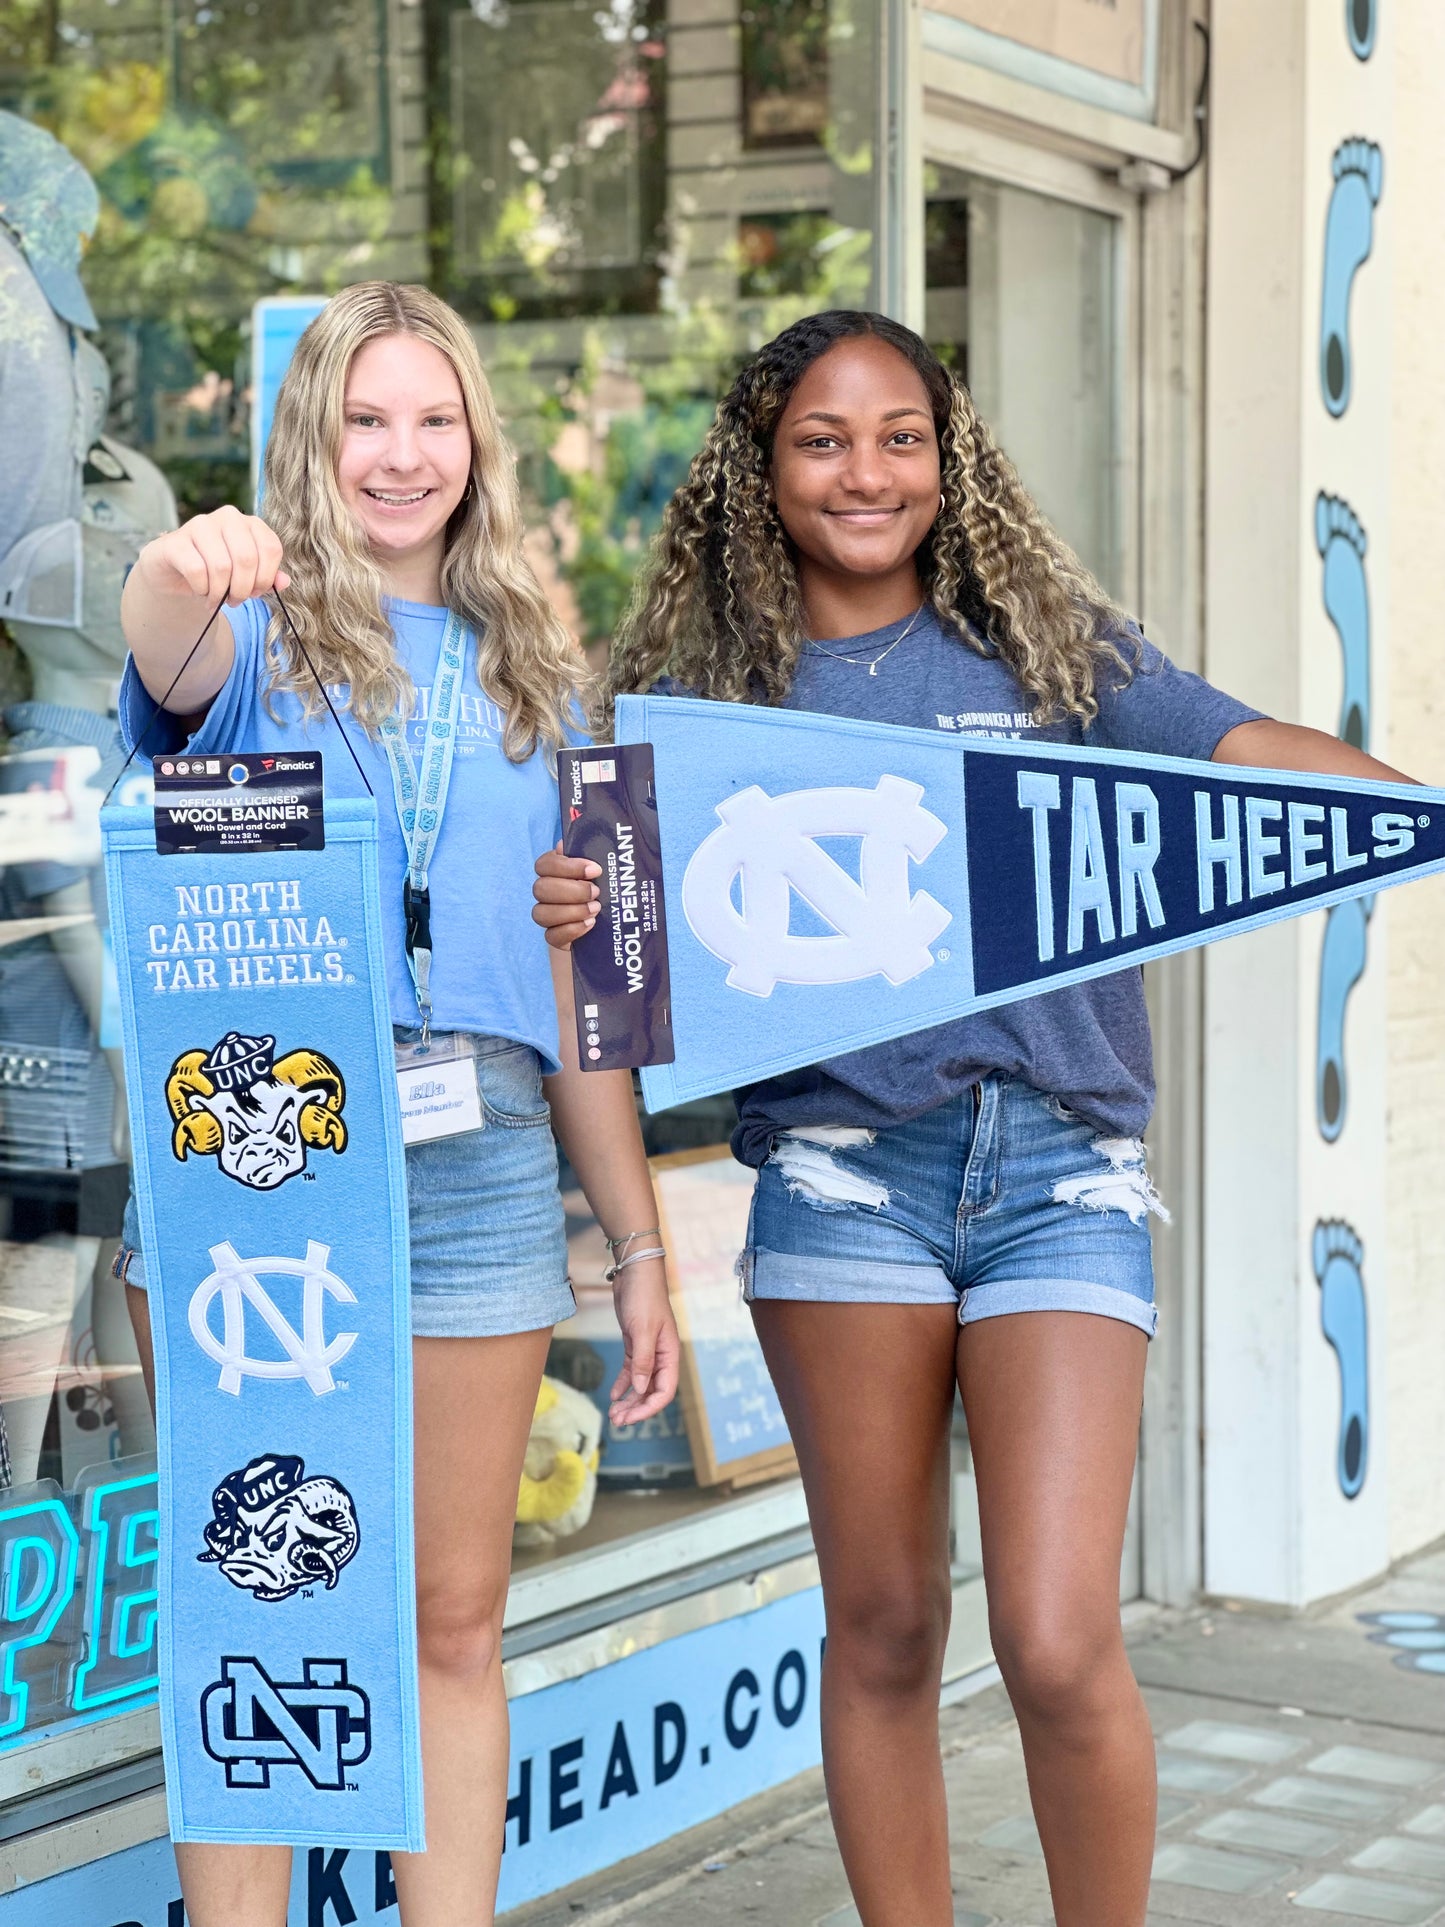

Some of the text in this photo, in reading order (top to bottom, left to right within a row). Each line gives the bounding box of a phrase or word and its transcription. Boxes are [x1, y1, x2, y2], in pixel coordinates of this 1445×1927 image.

[437, 673, 455, 719] CAROLINA
[936, 714, 957, 729] THE
[956, 712, 1012, 728] SHRUNKEN
[276, 761, 315, 771] Fanatics
[391, 740, 413, 800] CAROLINA
[425, 744, 445, 804] CAROLINA
[570, 760, 582, 805] Fanatics
[169, 805, 309, 823] WOOL BANNER
[179, 795, 299, 807] OFFICIALLY LICENSED
[193, 821, 286, 832] With Dowel and Cord
[414, 840, 428, 889] ROLINA
[1017, 770, 1166, 962] TAR
[175, 880, 302, 916] NORTH
[640, 881, 649, 889] in
[641, 890, 649, 903] 32
[608, 852, 624, 966] OFFICIALLY LICENSED
[616, 822, 644, 993] WOOL PENNANT
[642, 912, 650, 920] in
[642, 921, 651, 932] 13
[147, 957, 219, 991] TAR
[216, 1056, 269, 1089] UNC
[409, 1081, 445, 1101] Ella
[243, 1471, 289, 1505] UNC
